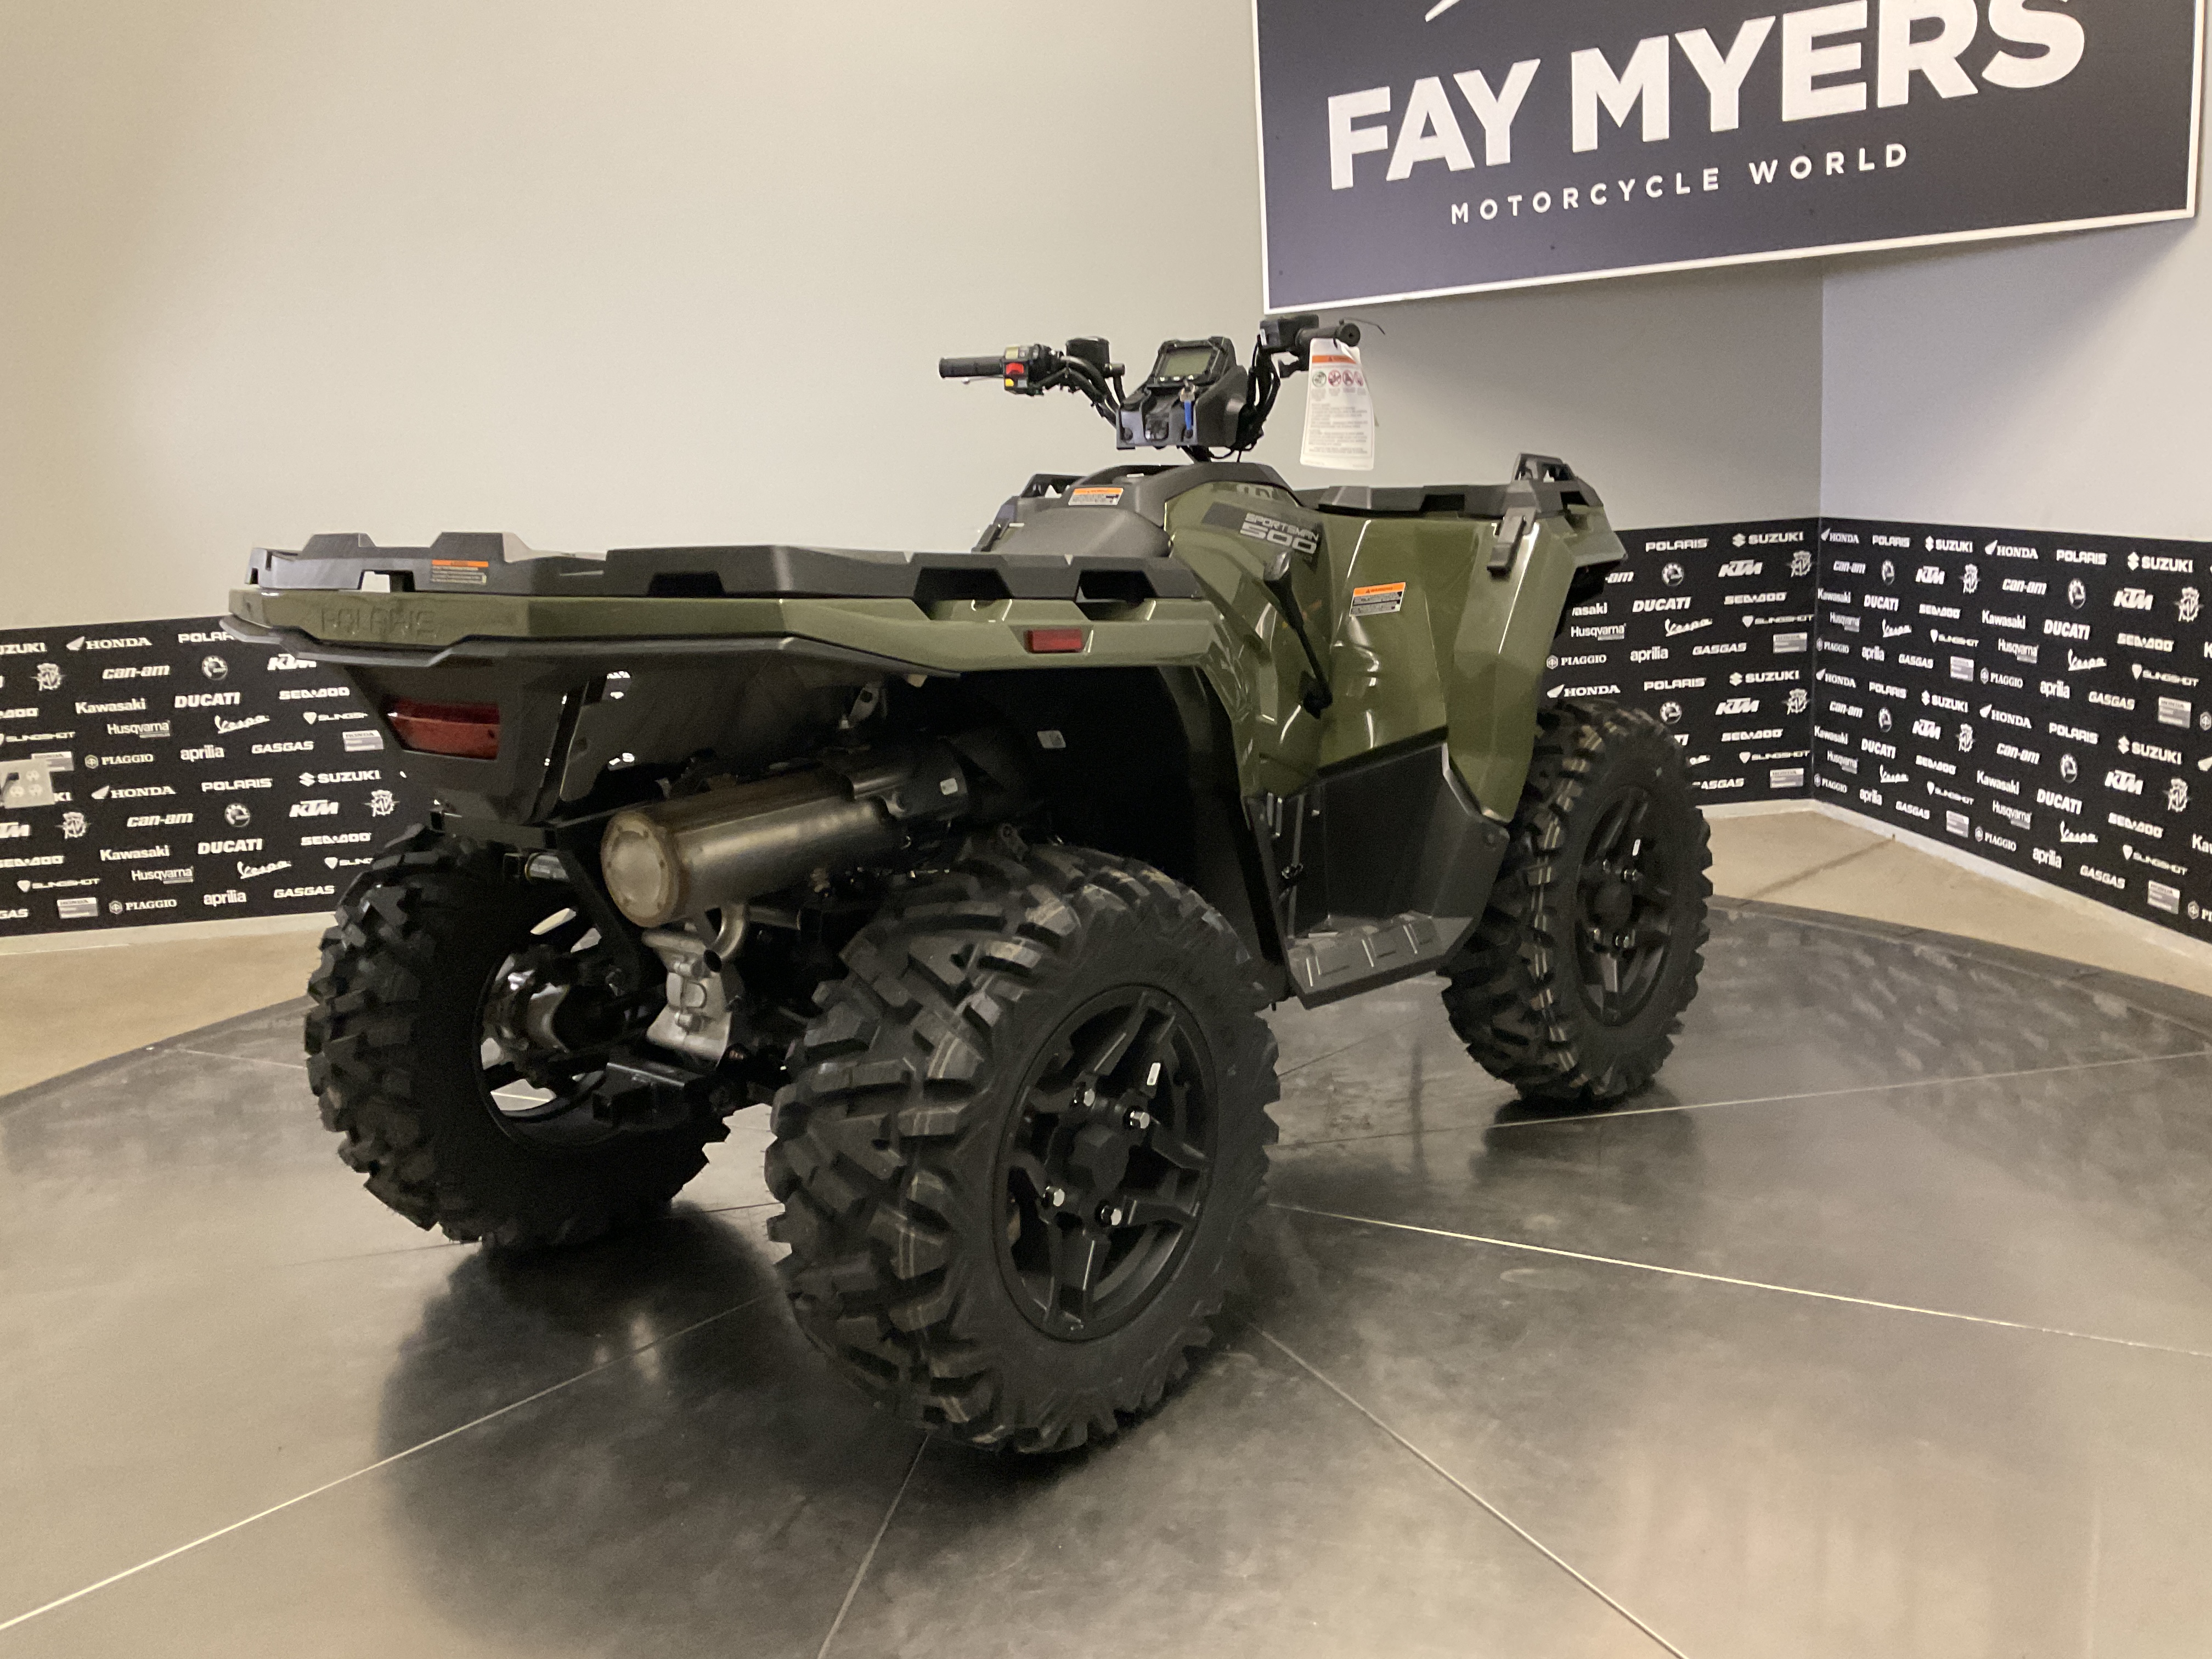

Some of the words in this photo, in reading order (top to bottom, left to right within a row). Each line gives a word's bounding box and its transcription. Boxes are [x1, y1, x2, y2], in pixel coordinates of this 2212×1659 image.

[1328, 59, 1541, 190] FAY
[1571, 0, 2085, 152] MYERS
[1450, 168, 1720, 224] MOTORCYCLE
[1748, 143, 1909, 184] WORLD
[1240, 522, 1317, 554] 500
[1645, 538, 1708, 552] POLARIS
[1748, 531, 1803, 545] SUZUKI
[1829, 533, 1859, 544] HONDA
[1872, 535, 1910, 548] POLARIS
[1936, 539, 1973, 553] SUZUKI
[1996, 545, 2039, 560] HONDA
[2056, 549, 2108, 565] POLARIS
[1718, 559, 1763, 578] KTM
[2141, 556, 2193, 573] SUZUKI
[1915, 566, 1945, 585] KTM
[1818, 588, 1851, 603] Kawasaki
[1864, 594, 1899, 612] DUCATI
[2113, 588, 2153, 611] KTM
[1632, 596, 1691, 613] DUCATI
[1664, 618, 1712, 637] Vespa
[1982, 610, 2026, 630] Kawasaki
[178, 631, 234, 644] POLAR
[1571, 624, 1626, 637] Husqvarna
[2043, 619, 2090, 640] DUCATI
[0, 642, 47, 655] UZUKI
[85, 637, 153, 650] HONDA
[1692, 642, 1747, 656] GASGAS
[1824, 641, 1849, 653] PIAGGIO
[1561, 654, 1607, 666] PIAGGIO
[1630, 646, 1668, 663] aprilia
[1861, 645, 1884, 662] aprilia
[1898, 653, 1934, 669] GASGAS
[1644, 678, 1706, 691] POLARIS
[1745, 670, 1799, 683] SUZUKI
[1825, 673, 1857, 689] HONDA
[1990, 672, 2023, 689] PIAGGIO
[1564, 685, 1621, 697] HONDA
[1869, 681, 1906, 699] POLARIS
[2040, 680, 2070, 699] aprilia
[75, 697, 146, 714] Kawasaki
[174, 692, 241, 708] DUCATI
[1715, 697, 1760, 715] KTM
[1931, 695, 1968, 713] SUZUKI
[2088, 691, 2135, 710] GASGAS
[214, 715, 270, 734] Vespa
[1991, 709, 2032, 729] HONDA
[106, 720, 170, 736] Husqvarna
[1814, 725, 1848, 745] Kawasaki
[1912, 719, 1941, 740] KTM
[2049, 722, 2098, 744] POLARIS
[180, 744, 225, 762] aprilia
[251, 741, 314, 754] GASGAS
[1861, 738, 1896, 759] DUCATI
[2131, 741, 2182, 765] SUZUKI
[101, 753, 154, 765] PIAGGIO
[201, 778, 273, 792] POLARIS
[317, 770, 382, 783] SUZUKI
[1977, 770, 2019, 795] Kawasaki
[2104, 769, 2143, 795] KTM
[110, 786, 176, 799] HONDA
[1821, 778, 1847, 793] PIAGGIO
[1859, 788, 1882, 806] aprilia
[2036, 788, 2082, 815] DUCATI
[289, 799, 339, 817] KTM
[1895, 800, 1930, 820] GASGAS
[198, 838, 263, 855] DUCATI
[1984, 832, 2017, 851] PIAGGIO
[99, 844, 170, 861] Kawasaki
[2033, 848, 2062, 869] aprilia
[132, 866, 193, 882] Husqvarna
[237, 860, 292, 879] Vespa
[2080, 865, 2125, 889] GASGAS
[204, 889, 247, 907] aprilia
[273, 885, 335, 899] GASGAS
[125, 899, 177, 911] PIAGGIO
